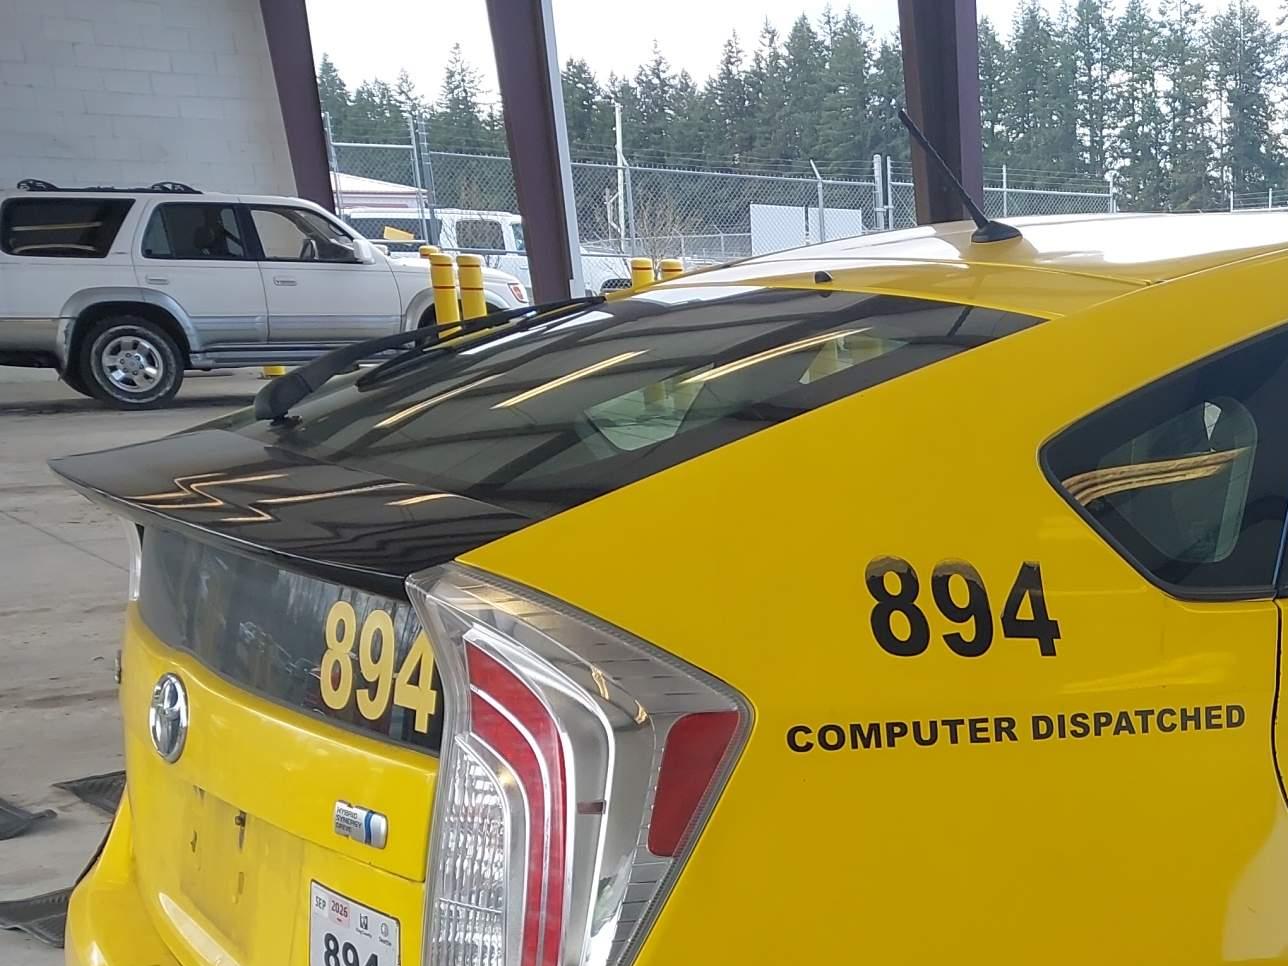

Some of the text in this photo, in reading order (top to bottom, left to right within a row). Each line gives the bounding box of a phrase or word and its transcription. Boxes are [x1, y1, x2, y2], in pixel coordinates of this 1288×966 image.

[864, 555, 1062, 658] 894
[320, 600, 437, 734] 894
[786, 703, 1246, 754] COMPUTER DISPATCHED
[315, 895, 327, 910] SEP
[331, 900, 348, 918] 2026
